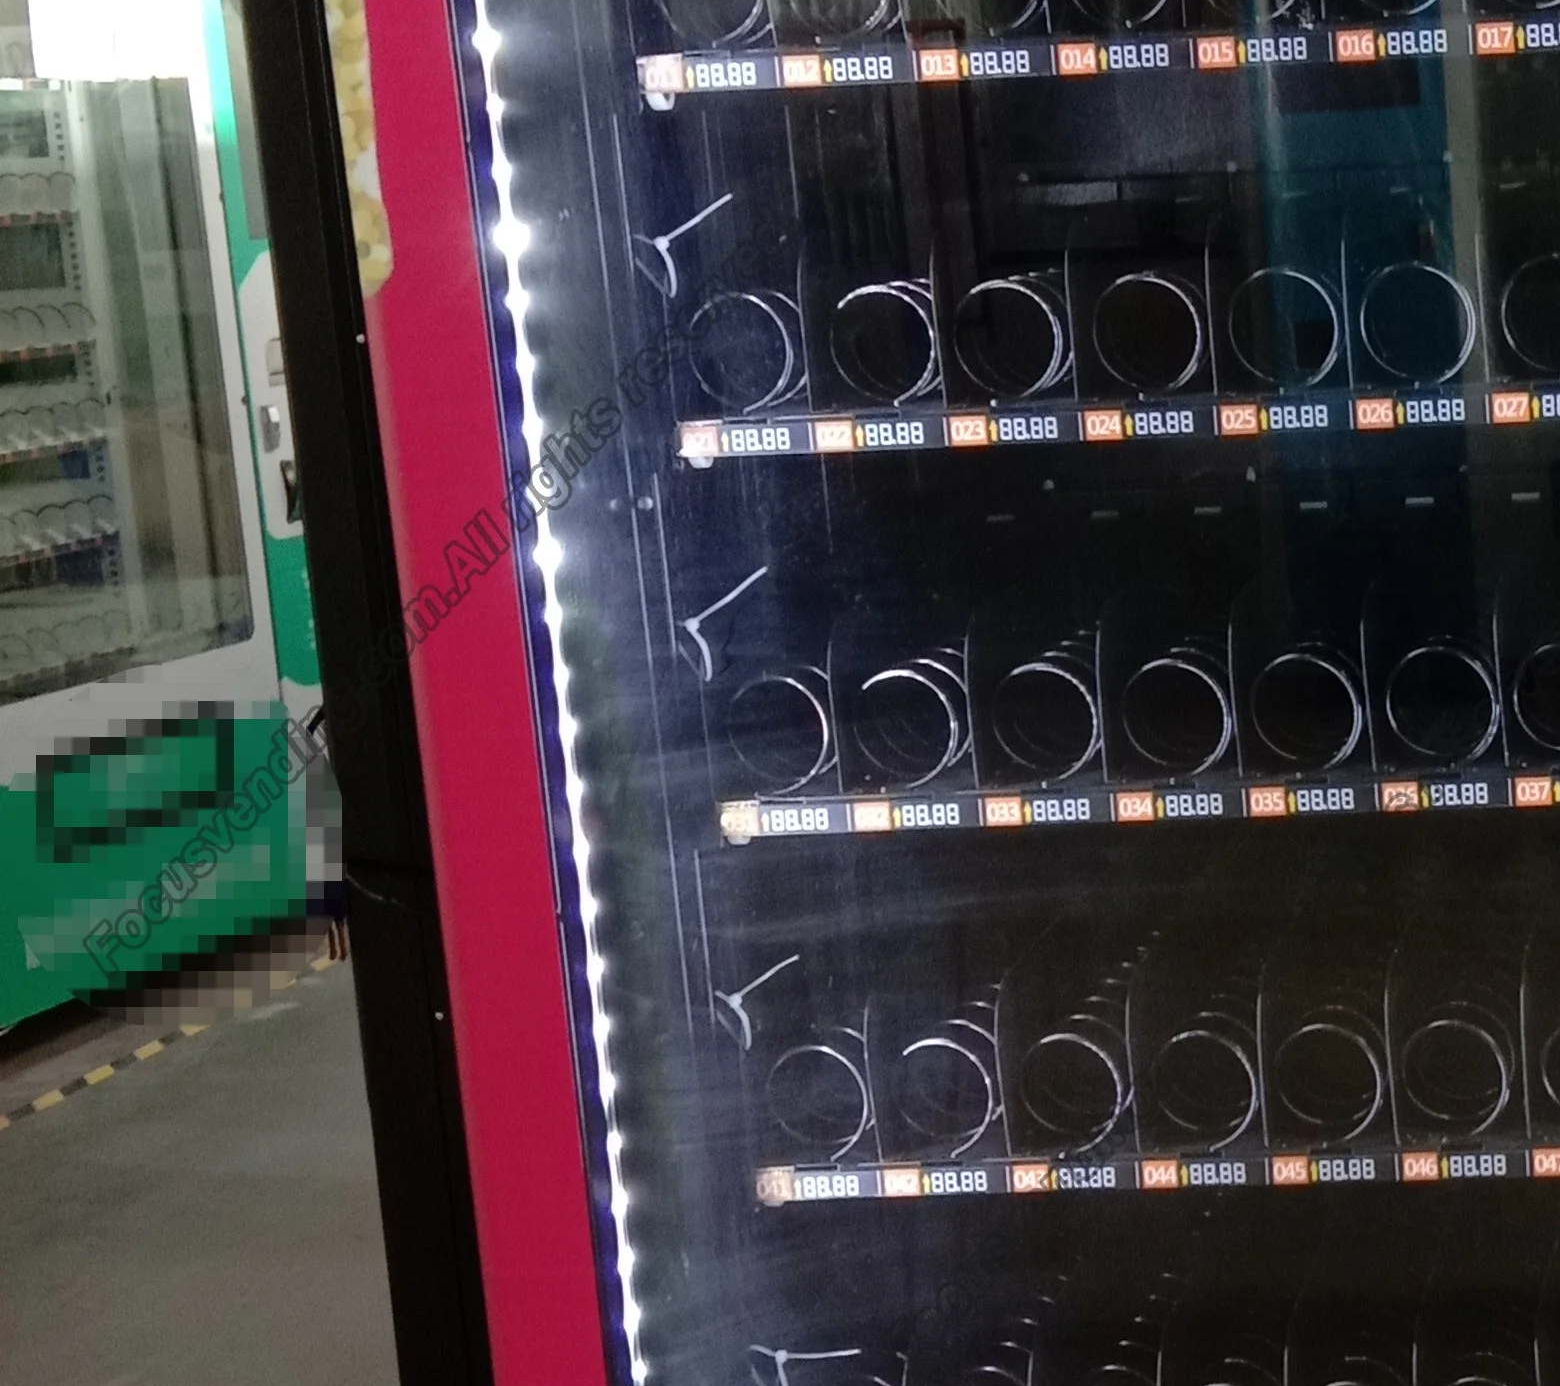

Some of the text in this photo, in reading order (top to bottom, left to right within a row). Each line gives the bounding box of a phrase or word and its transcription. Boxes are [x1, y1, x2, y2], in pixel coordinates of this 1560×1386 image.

[1199, 37, 1307, 63] 015 88.88
[1338, 29, 1447, 56] 016 88.88
[1478, 27, 1512, 50] 017
[833, 56, 893, 82] 88.88
[921, 50, 1030, 76] 013 88.88
[1061, 43, 1169, 70] 014 88.88
[695, 61, 756, 87] 88.88
[1222, 404, 1329, 431] 025 88.88
[1358, 398, 1465, 424] 026 88.88
[1494, 396, 1528, 418] 027
[865, 421, 924, 446] 88.88
[952, 416, 1058, 442] 023 88.88
[1087, 410, 1194, 436] 024 88.88
[731, 428, 790, 452] 88.88
[1251, 787, 1355, 814] 035 88.88
[1517, 781, 1550, 803] 037
[902, 802, 959, 826] 88.88
[987, 798, 1090, 822] 033 88.88
[1119, 793, 1223, 817] 034 88.88
[771, 807, 829, 831] 88.88
[1144, 1162, 1246, 1185] 044 88.88
[1273, 1157, 1375, 1181] 045 88.88
[1404, 1153, 1507, 1178] 046 88.88
[757, 1175, 859, 1198] 041 88.88
[930, 1170, 987, 1194] 88.88
